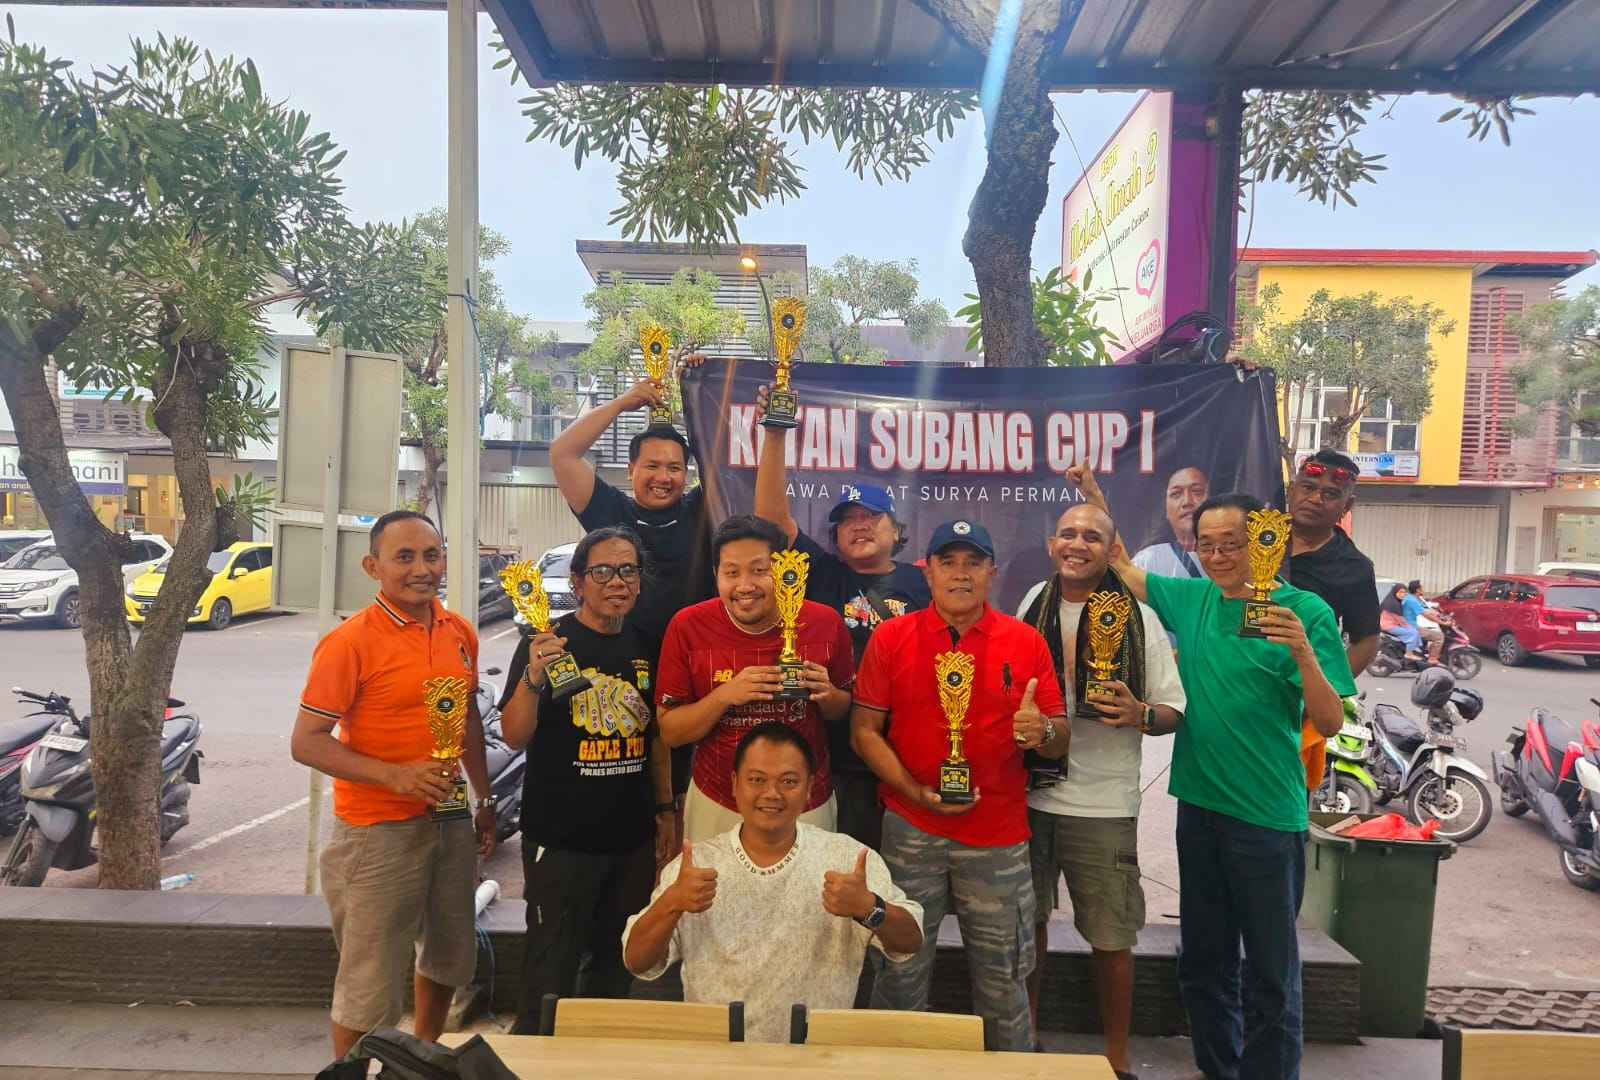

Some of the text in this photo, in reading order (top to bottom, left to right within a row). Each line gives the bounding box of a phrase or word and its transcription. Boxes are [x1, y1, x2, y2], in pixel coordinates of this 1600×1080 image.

[1145, 131, 1158, 188] 2
[869, 408, 1034, 472] SUBANG
[1046, 409, 1130, 473] CUP
[1139, 409, 1155, 473] I
[1352, 455, 1393, 463] INTERNUSA
[785, 483, 830, 499] AWA
[920, 486, 989, 502] SURYA
[1001, 487, 1087, 502] PERMAN
[578, 739, 621, 761] GAPLE
